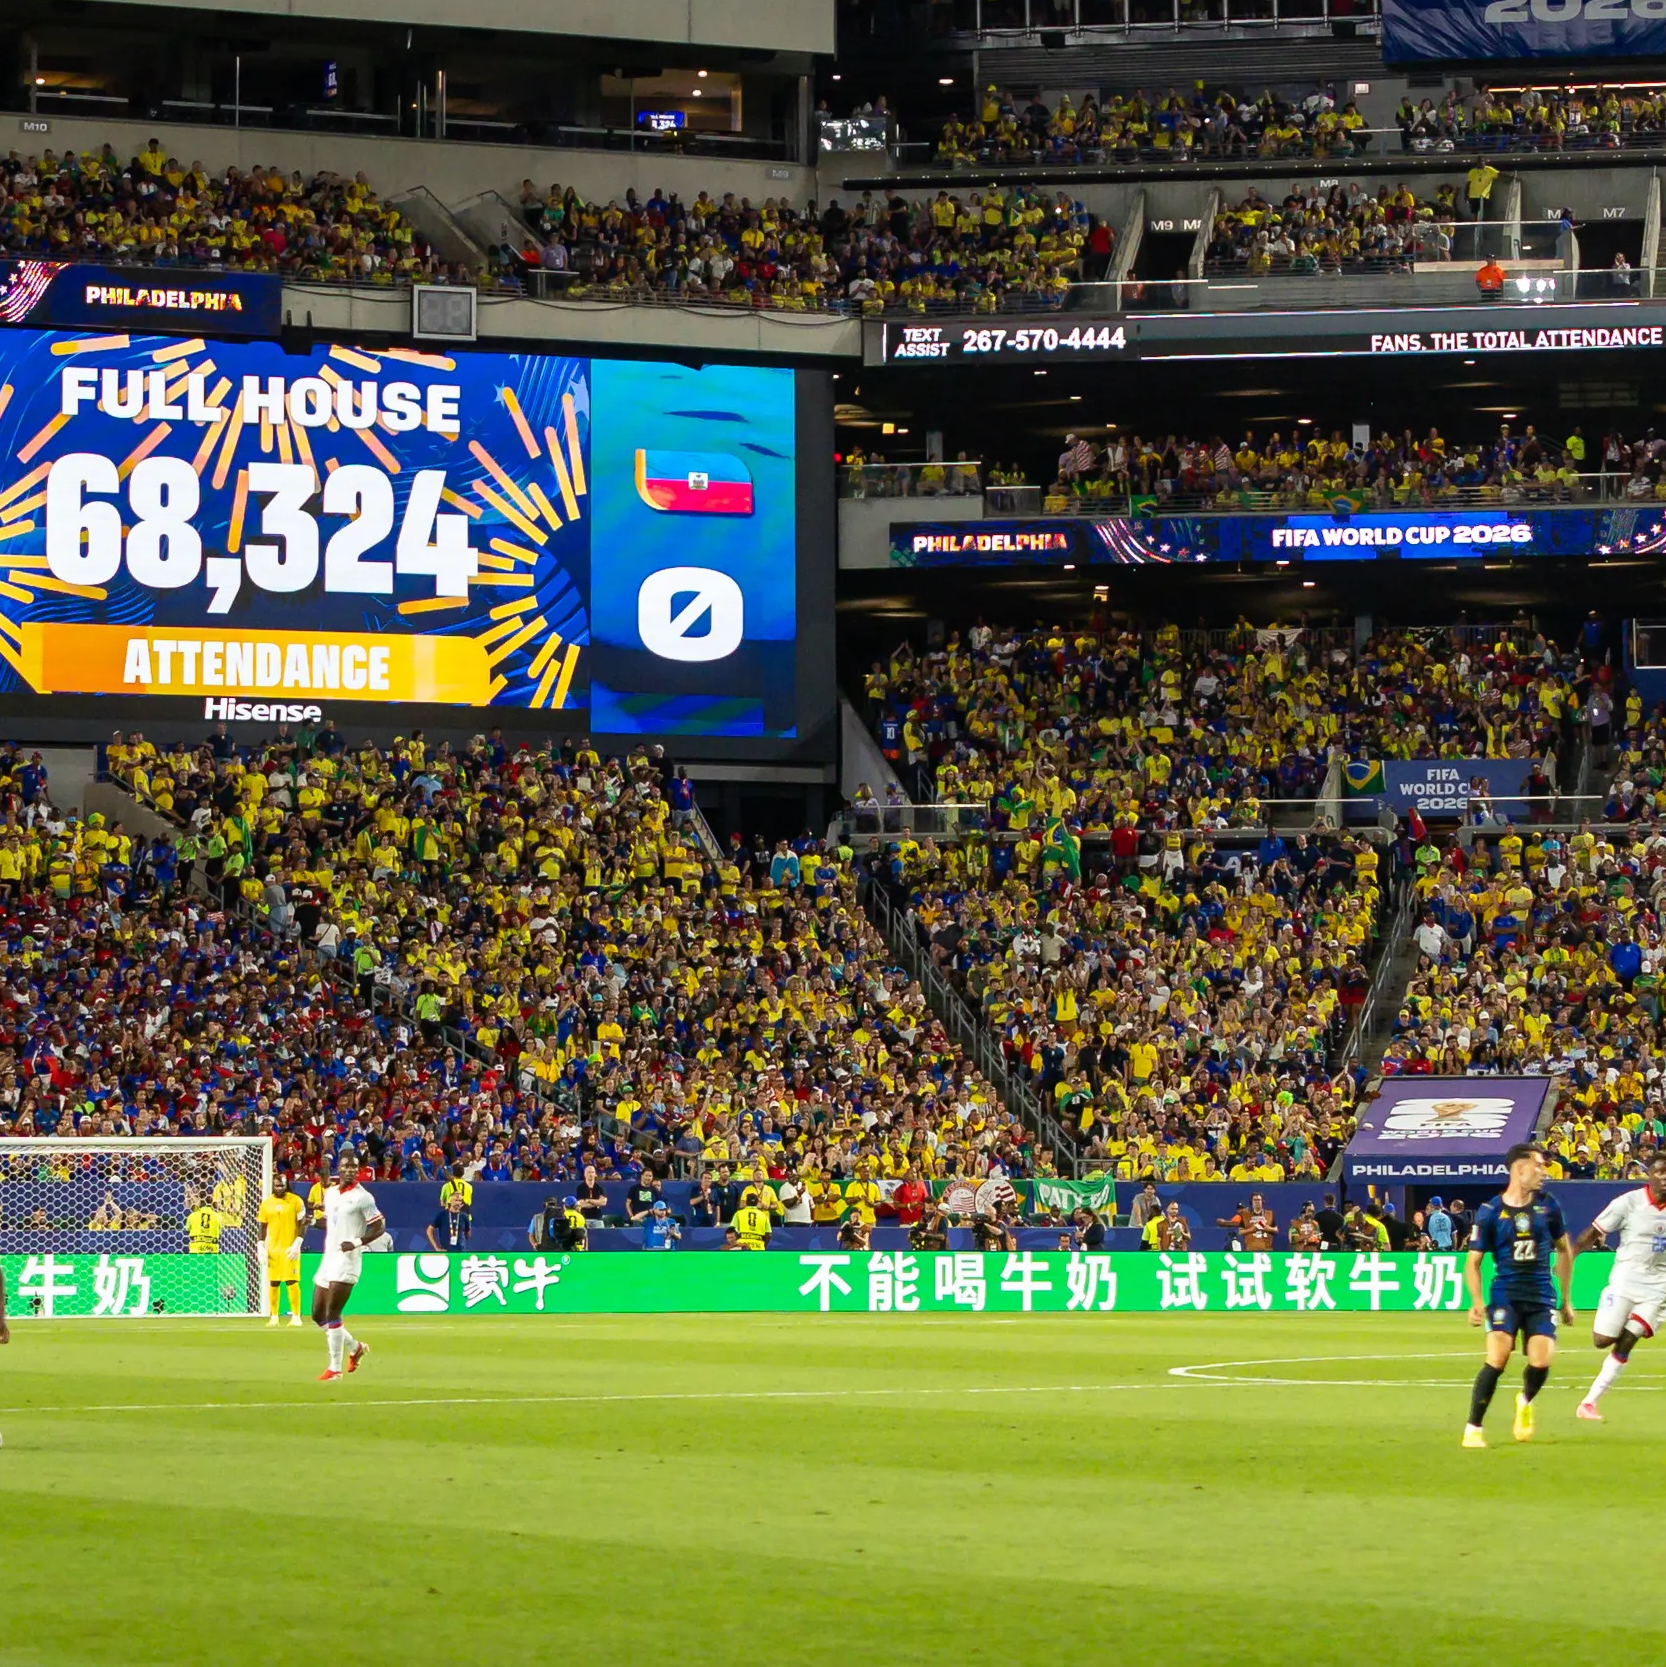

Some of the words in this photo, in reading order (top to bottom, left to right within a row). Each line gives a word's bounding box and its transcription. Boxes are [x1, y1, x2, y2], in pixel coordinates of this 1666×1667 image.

[23, 122, 48, 133] M10
[1602, 208, 1626, 219] M7
[1150, 221, 1174, 231] M9
[85, 286, 243, 312] PHILADELPHIA
[893, 342, 951, 358] ASSIST
[902, 328, 943, 343] TEXT
[963, 326, 1126, 354] 267-570-4444
[1430, 332, 1469, 351] THE
[1471, 330, 1533, 349] TOTAL
[1535, 326, 1663, 348] ATTENDANCE
[60, 367, 223, 422] FULL
[243, 375, 462, 433] HOUSE
[45, 452, 479, 614] 68,324
[913, 532, 1068, 553] PHILADELPHIA
[1272, 529, 1320, 548] FIFA
[1323, 527, 1402, 547] WORLD
[1405, 526, 1452, 545] CUP
[1453, 524, 1532, 544] 2026
[637, 566, 745, 662] 0
[122, 637, 390, 691] ATTENDANCE
[204, 696, 322, 724] Hisense
[1427, 769, 1461, 781] FIFA
[1399, 783, 1457, 796] WORLD
[1352, 1165, 1510, 1176] PHILADELPHIA
[1513, 1240, 1537, 1261] 22
[460, 1254, 561, 1311] 蒙牛
[798, 1252, 1118, 1312] 不能喝牛奶
[1155, 1251, 1464, 1312] 试试软牛奶
